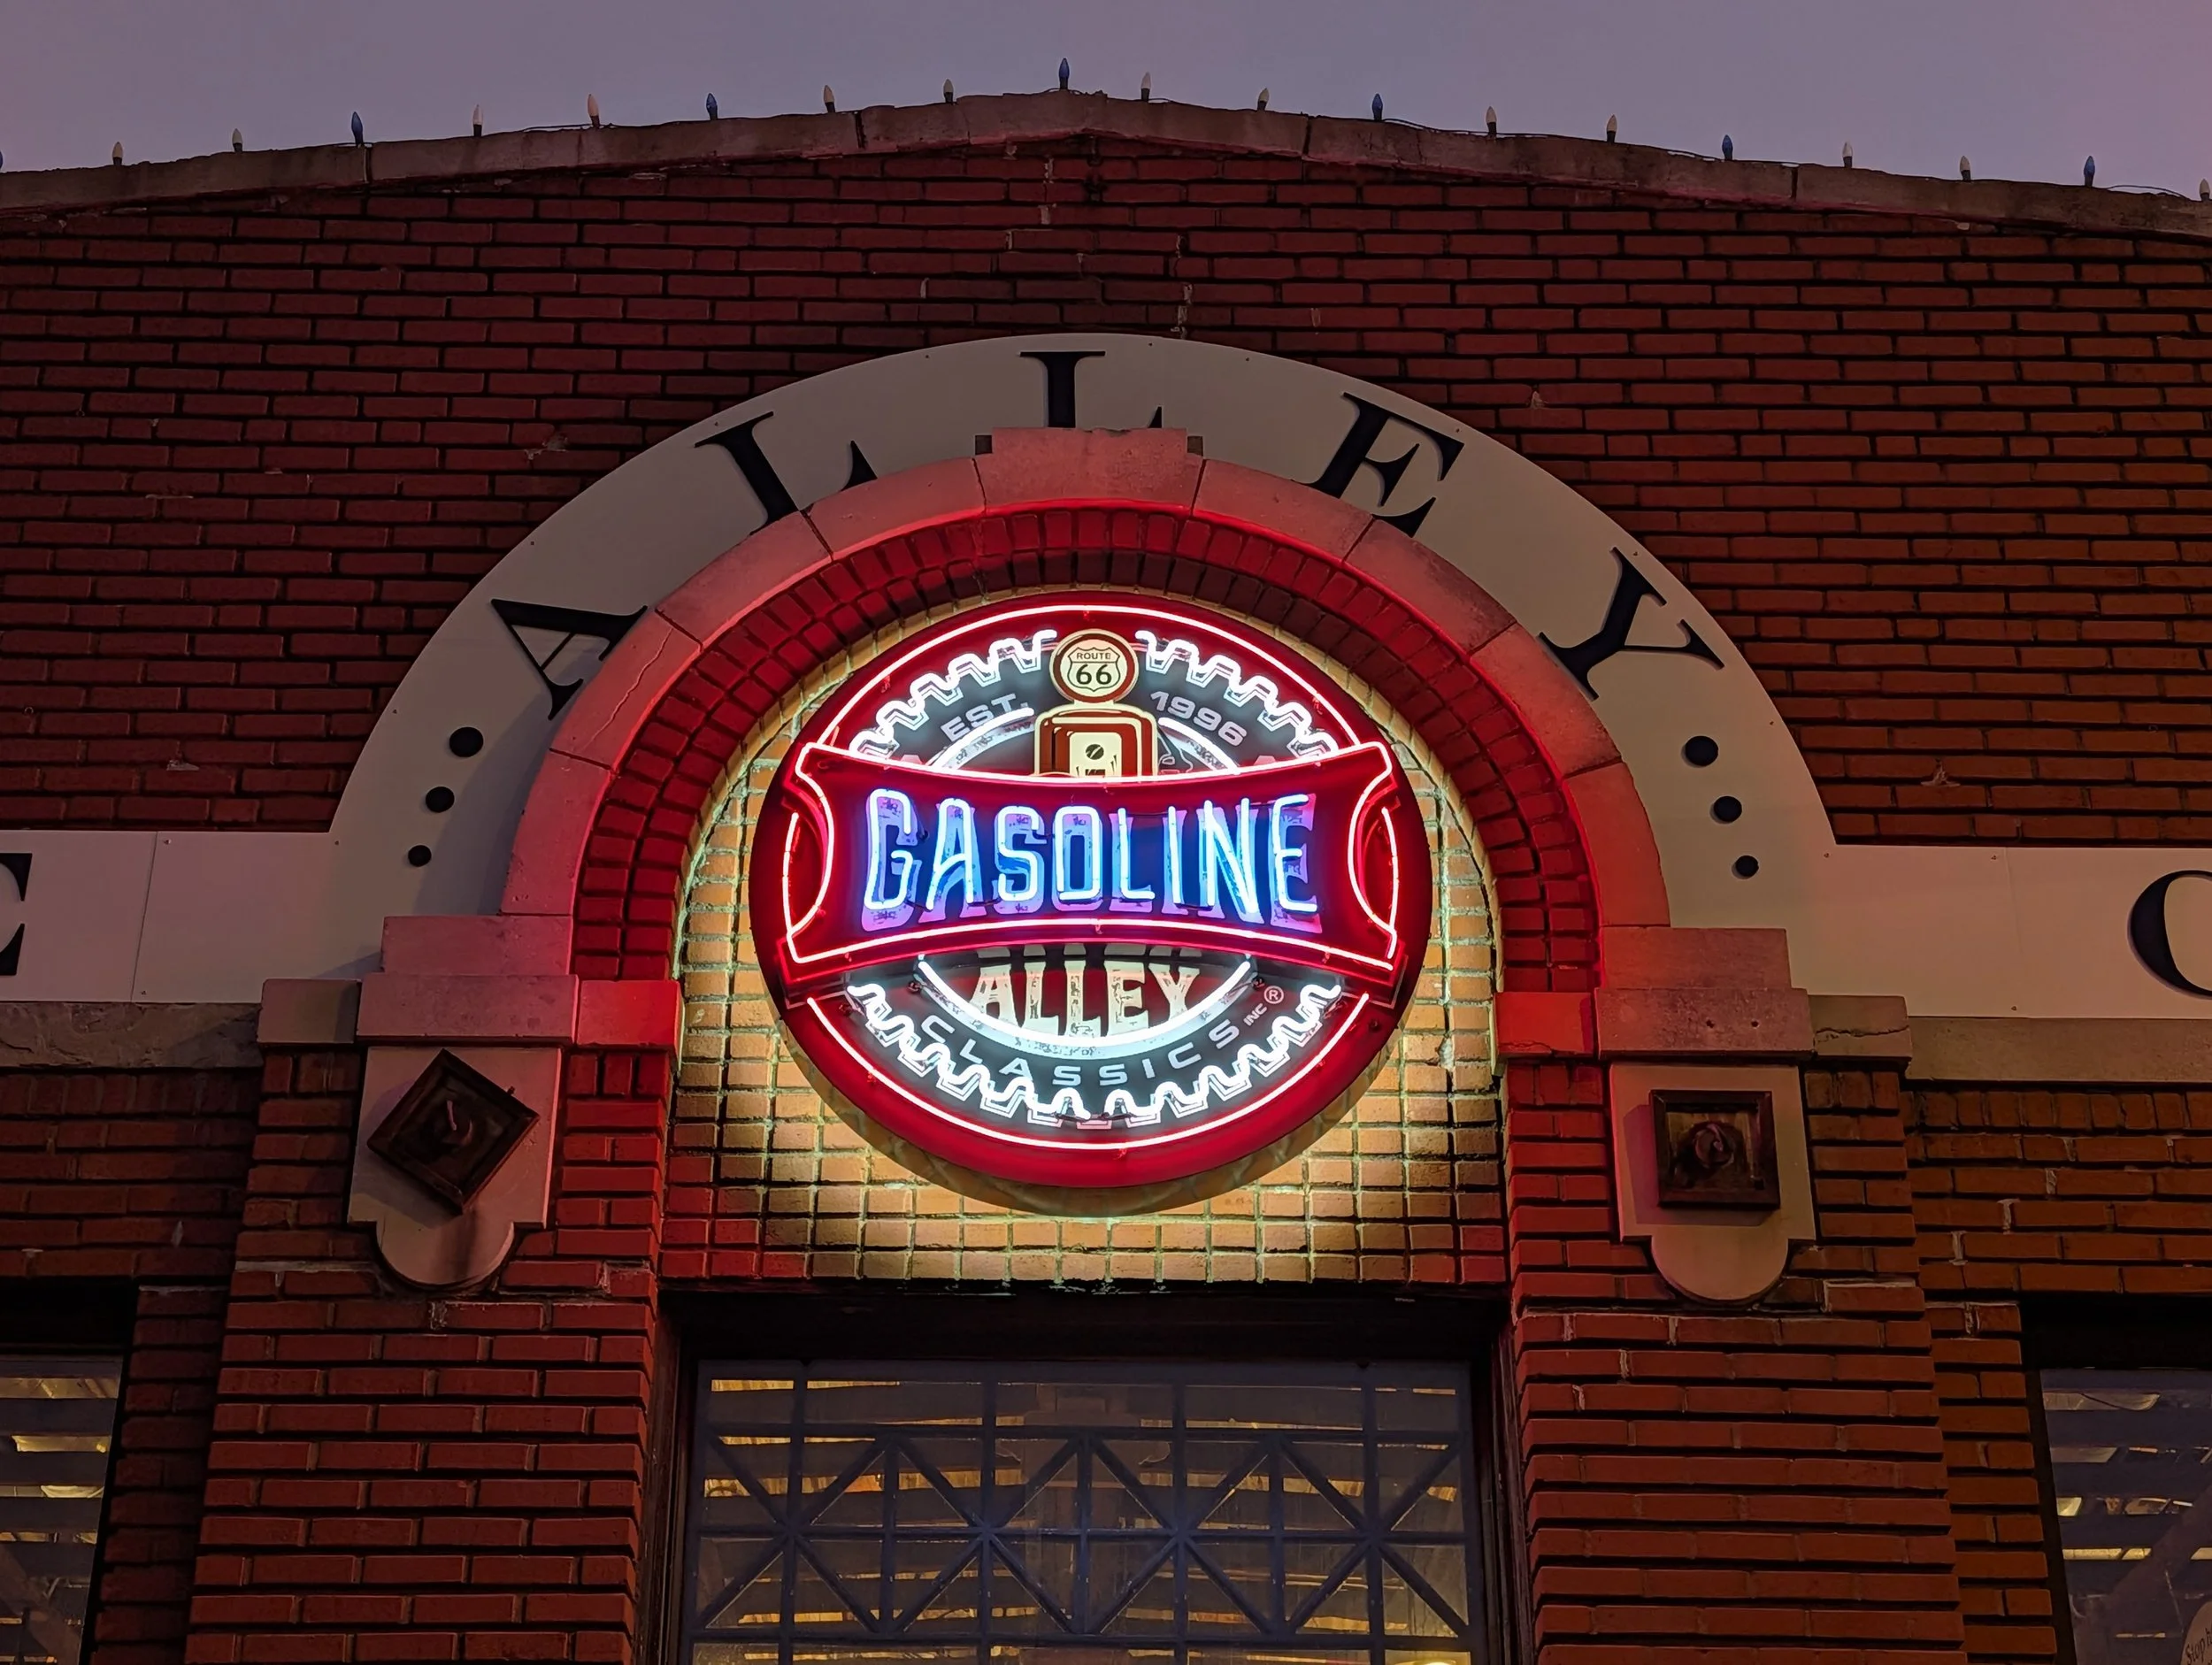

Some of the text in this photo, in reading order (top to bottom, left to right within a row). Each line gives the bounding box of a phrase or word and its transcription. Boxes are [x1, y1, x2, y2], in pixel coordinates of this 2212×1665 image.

[491, 350, 1725, 721] ALLEY
[1076, 652, 1112, 661] ROUTE
[1076, 664, 1112, 686] 66
[941, 690, 1248, 746] EST. 1996
[861, 788, 1323, 933] GASOLINE
[969, 959, 1201, 1039] ALLEY
[921, 1015, 1240, 1086] CLASSICS
